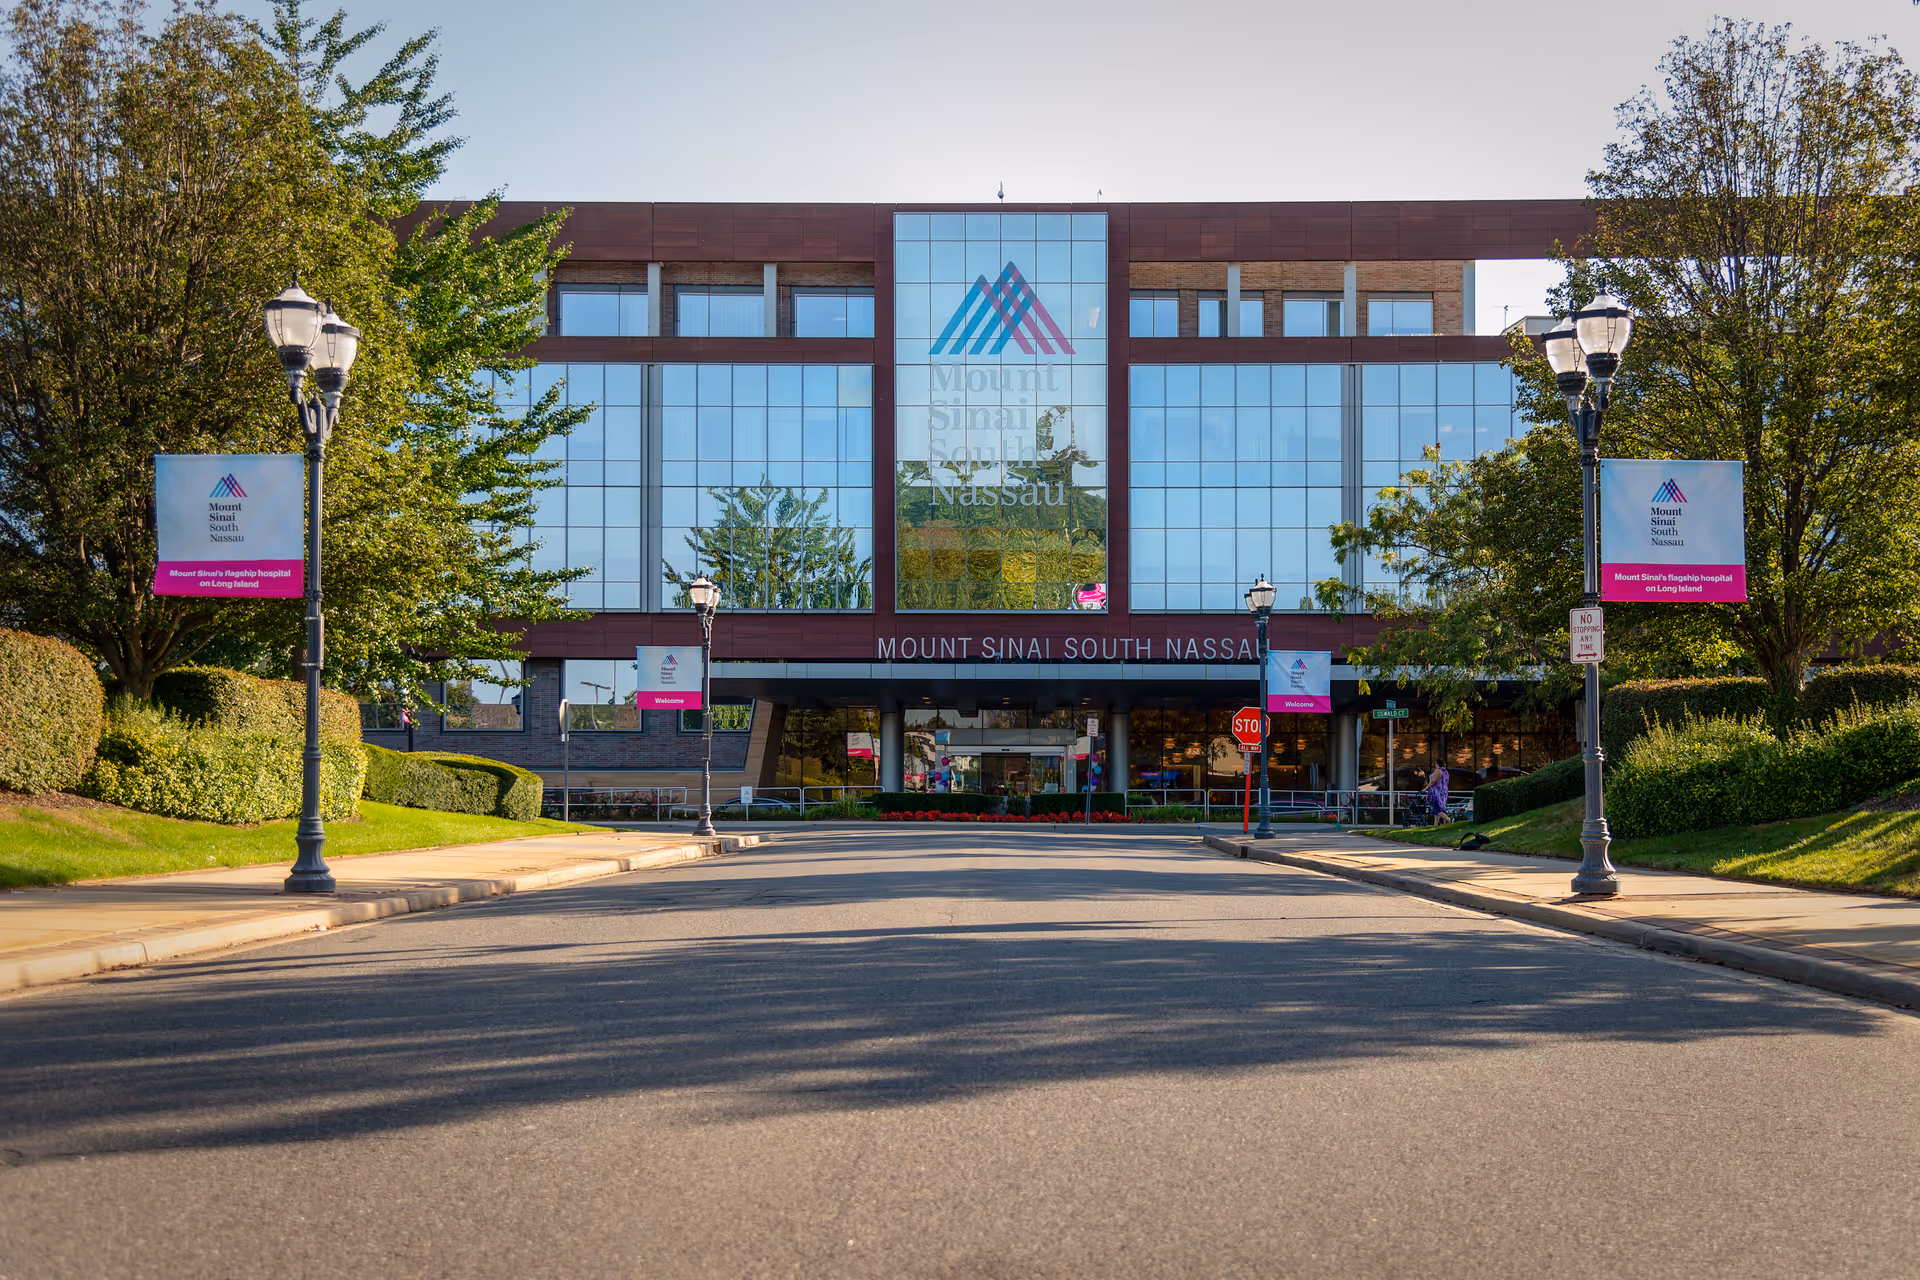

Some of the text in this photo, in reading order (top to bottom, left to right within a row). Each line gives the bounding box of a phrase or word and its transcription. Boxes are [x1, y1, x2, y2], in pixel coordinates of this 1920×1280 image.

[928, 362, 1059, 392] Mount
[928, 398, 1030, 430] Sinai
[928, 436, 1039, 469] South
[928, 476, 1067, 506] Nassau
[209, 503, 242, 511] Mount
[1650, 507, 1682, 516] Mount
[209, 513, 236, 522] Sinai
[1651, 517, 1676, 526] Sinai
[210, 523, 238, 532] South
[1651, 527, 1678, 536] South
[210, 534, 244, 542] Nassau
[1651, 538, 1684, 546] Nassau
[225, 569, 257, 580] flagship
[258, 570, 291, 579] hospital
[1614, 573, 1732, 584] Mount Sinai's flagship hospital
[212, 580, 232, 589] Long
[234, 580, 259, 588] Island
[1657, 585, 1677, 594] Long
[1580, 614, 1592, 624] NO
[1573, 625, 1600, 633] STOPPING
[878, 637, 972, 659] MOUNT
[981, 637, 1050, 659] SINAI
[1064, 637, 1151, 659] SOUTH
